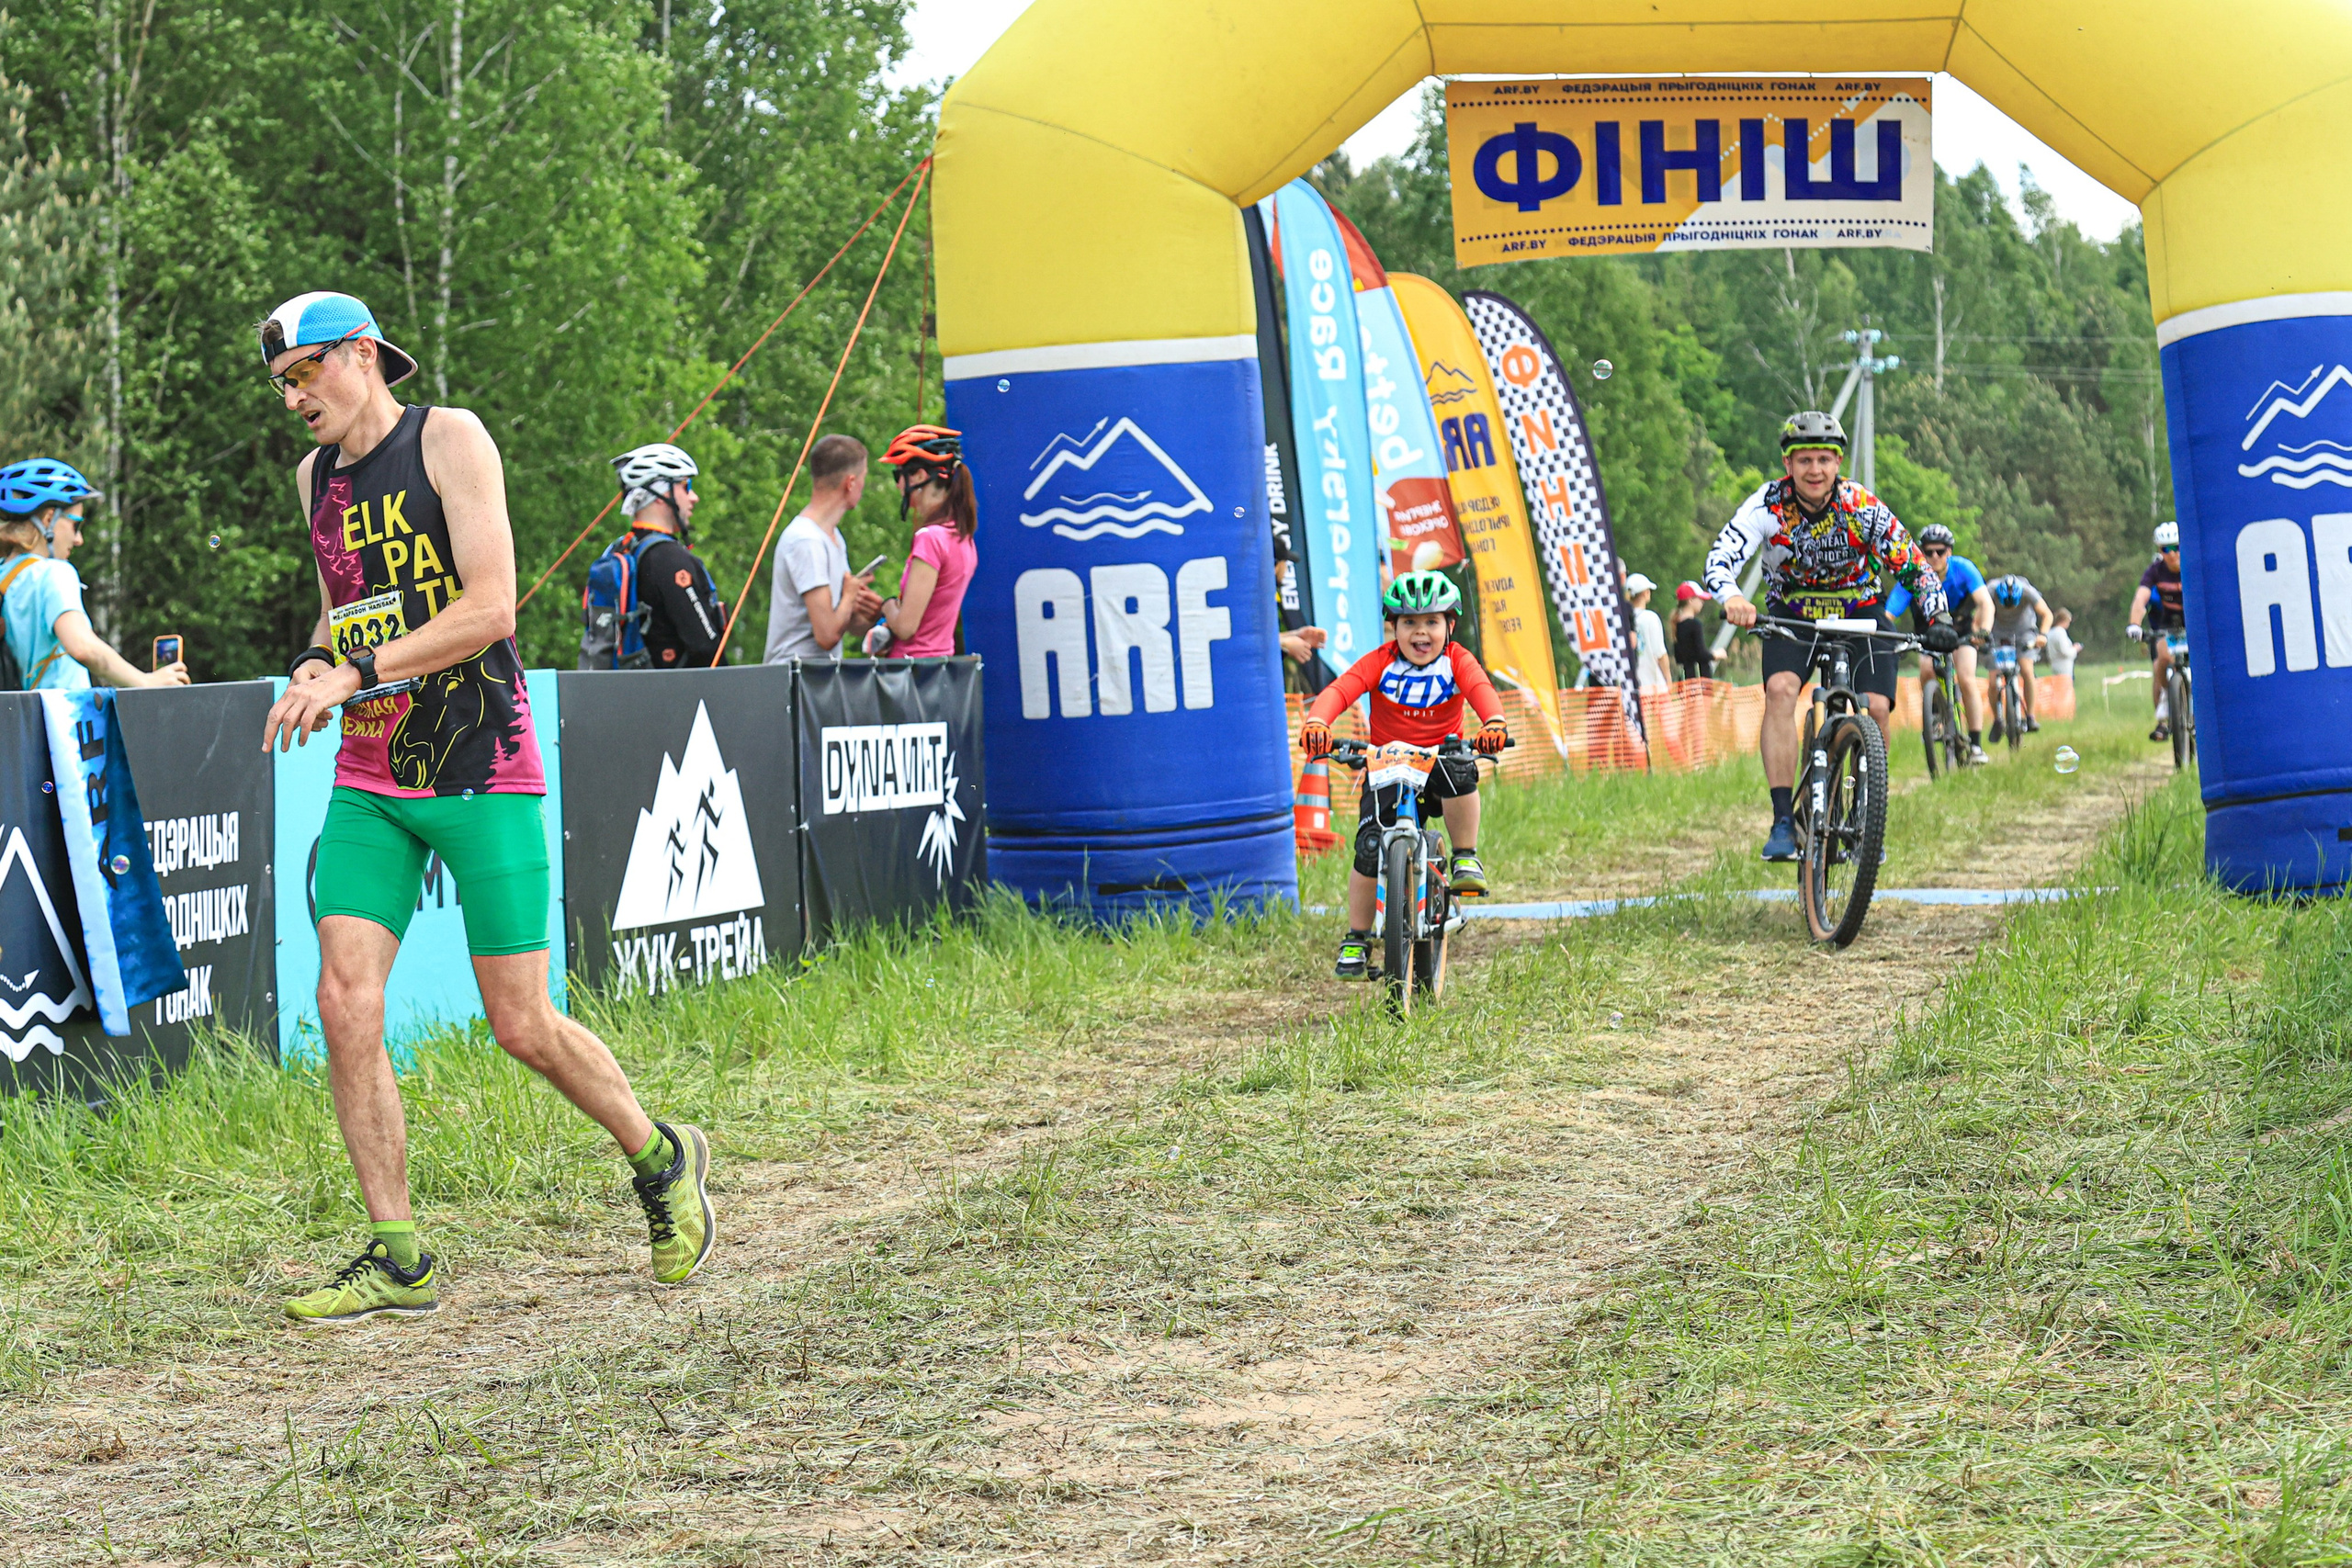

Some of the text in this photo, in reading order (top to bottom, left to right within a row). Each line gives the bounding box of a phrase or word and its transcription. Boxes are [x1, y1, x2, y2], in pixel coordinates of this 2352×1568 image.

[1493, 81, 1882, 96] ARF.BY ФЕДЭРАЦЫЯ ПРЫГОДНІЦКІХ ГОНАК ARF.BY
[1473, 118, 1903, 212] ФІНІШ
[1501, 228, 1883, 254] ARF.BY ФЕДЭРАЦЫЯ ПРЫГОДНІЦКІХ ГОНАК ARF.BY
[1264, 442, 1287, 514] DRINK
[343, 490, 413, 552] ELK
[382, 534, 445, 586] PA
[338, 614, 401, 656] 6032
[1014, 556, 1231, 720] ARF
[1378, 671, 1456, 709] FOX
[162, 884, 249, 952] ОДНІЦКІХ
[613, 911, 768, 1001] ЖУК-ТРЕЙЛ
